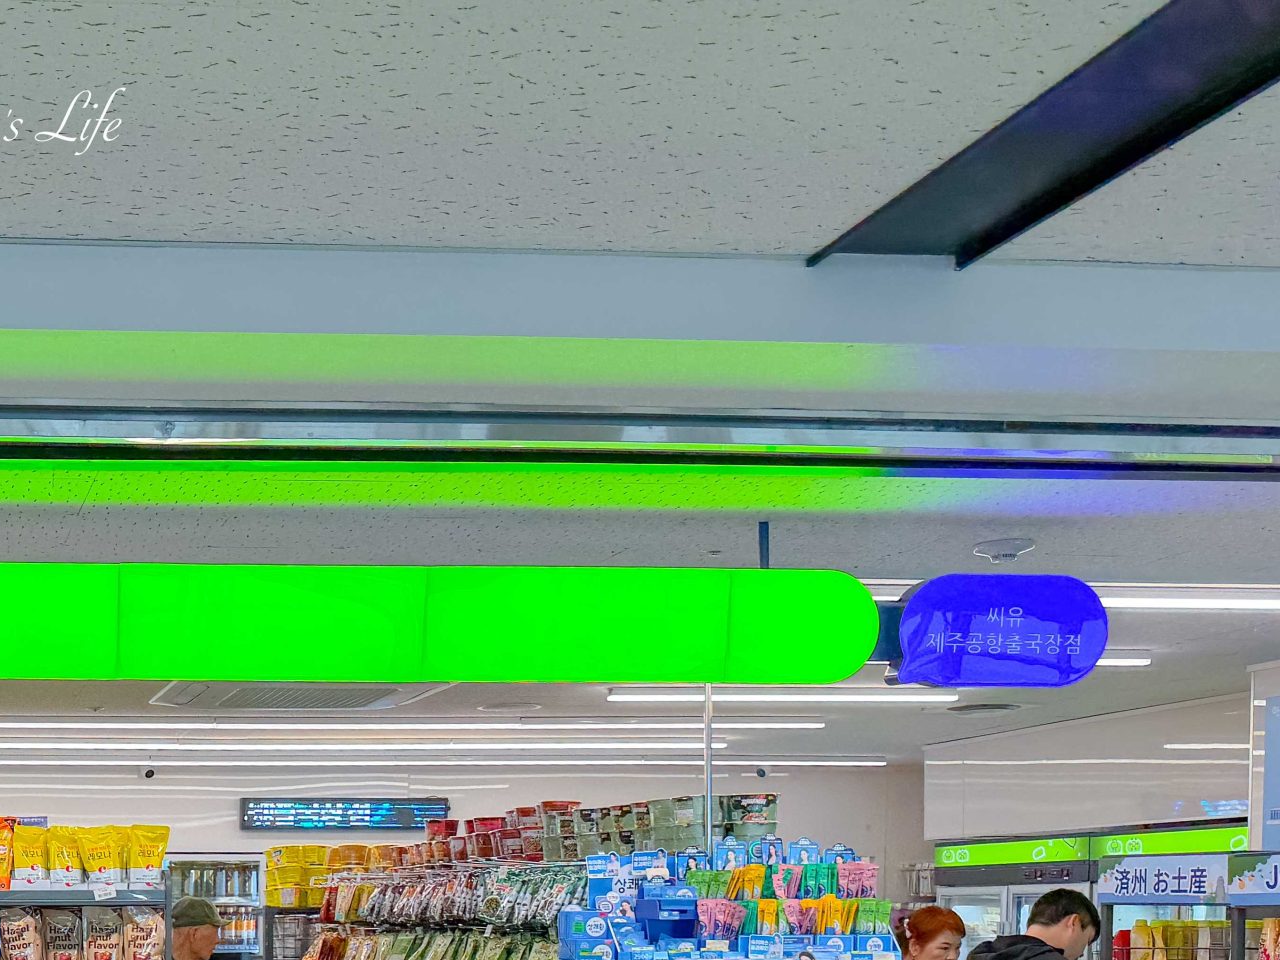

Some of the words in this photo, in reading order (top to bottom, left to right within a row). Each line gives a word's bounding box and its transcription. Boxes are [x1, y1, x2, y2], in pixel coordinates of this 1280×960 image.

[987, 606, 1025, 628] 씨유
[926, 633, 1081, 655] 제주공항출국장점
[1115, 868, 1147, 895] 済州
[1154, 867, 1208, 894] お土産
